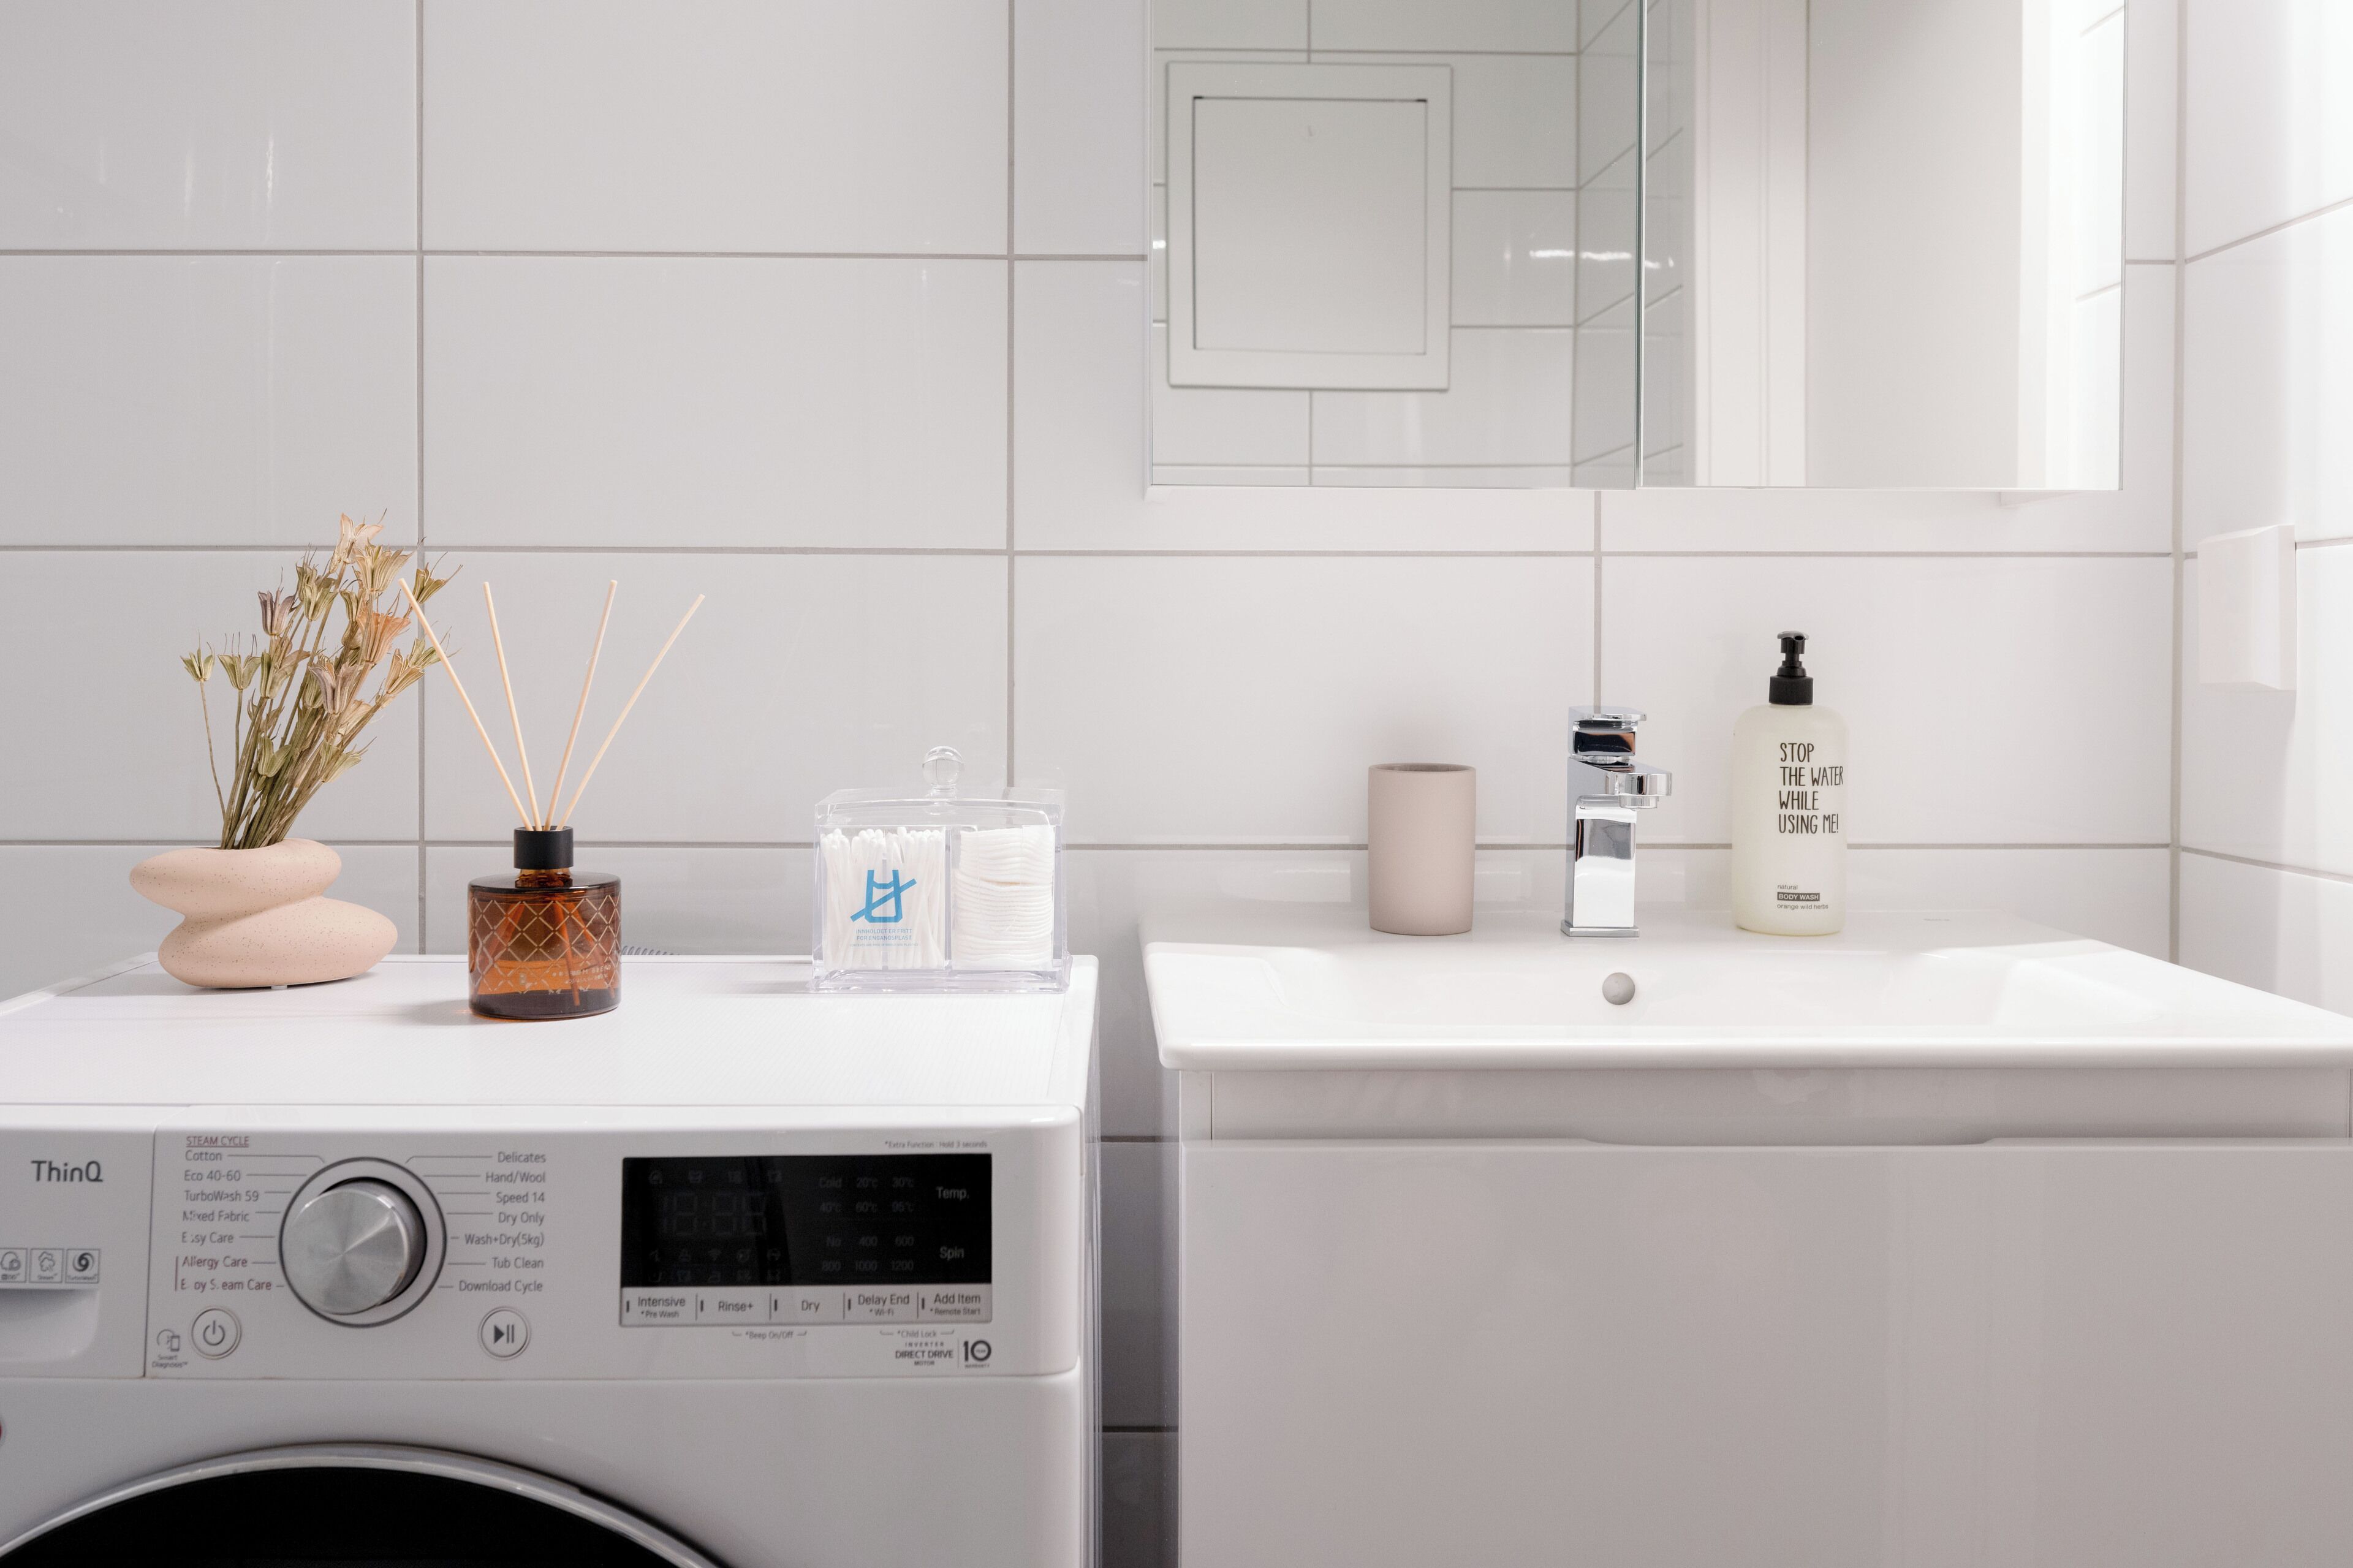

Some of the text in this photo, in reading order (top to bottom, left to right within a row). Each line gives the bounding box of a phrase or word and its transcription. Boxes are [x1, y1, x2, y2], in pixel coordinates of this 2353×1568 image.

[1779, 742, 1814, 762] STOP
[1779, 766, 1844, 786] THE WATER
[1779, 790, 1819, 810] WHILE
[1778, 813, 1839, 834] USING ME!
[186, 1136, 249, 1146] STEAM CYCLE
[185, 1149, 222, 1161] Cotton
[498, 1151, 547, 1163] Delicates
[31, 1160, 104, 1182] ThinQ
[184, 1170, 241, 1181] Eco 40-60
[485, 1171, 546, 1183] Hand/Wool
[184, 1190, 260, 1202] TurboWash 59
[496, 1192, 545, 1205] Speed 14
[936, 1186, 969, 1200] Temp.
[218, 1210, 250, 1222] Fabric
[498, 1211, 545, 1226] Dry Only
[181, 1231, 234, 1246] Esy Care
[464, 1232, 545, 1248] Wash+Dry(5kg)
[939, 1246, 964, 1261] Spin
[181, 1256, 248, 1270] Allergy Care
[491, 1257, 544, 1268] Tub Clean
[210, 1278, 244, 1290] Seam
[246, 1278, 272, 1290] Care
[459, 1279, 544, 1294] Download Cycle
[637, 1296, 686, 1307] Intensive
[858, 1293, 910, 1306] Delay End
[933, 1292, 981, 1305] Add Item
[718, 1300, 754, 1312] Rinse+
[801, 1299, 820, 1312] Dry
[963, 1307, 981, 1316] Start
[659, 1310, 680, 1319] Wash
[768, 1330, 794, 1339] On/Off
[920, 1330, 937, 1338] Lock
[895, 1349, 954, 1359] DIRECT DRIVE
